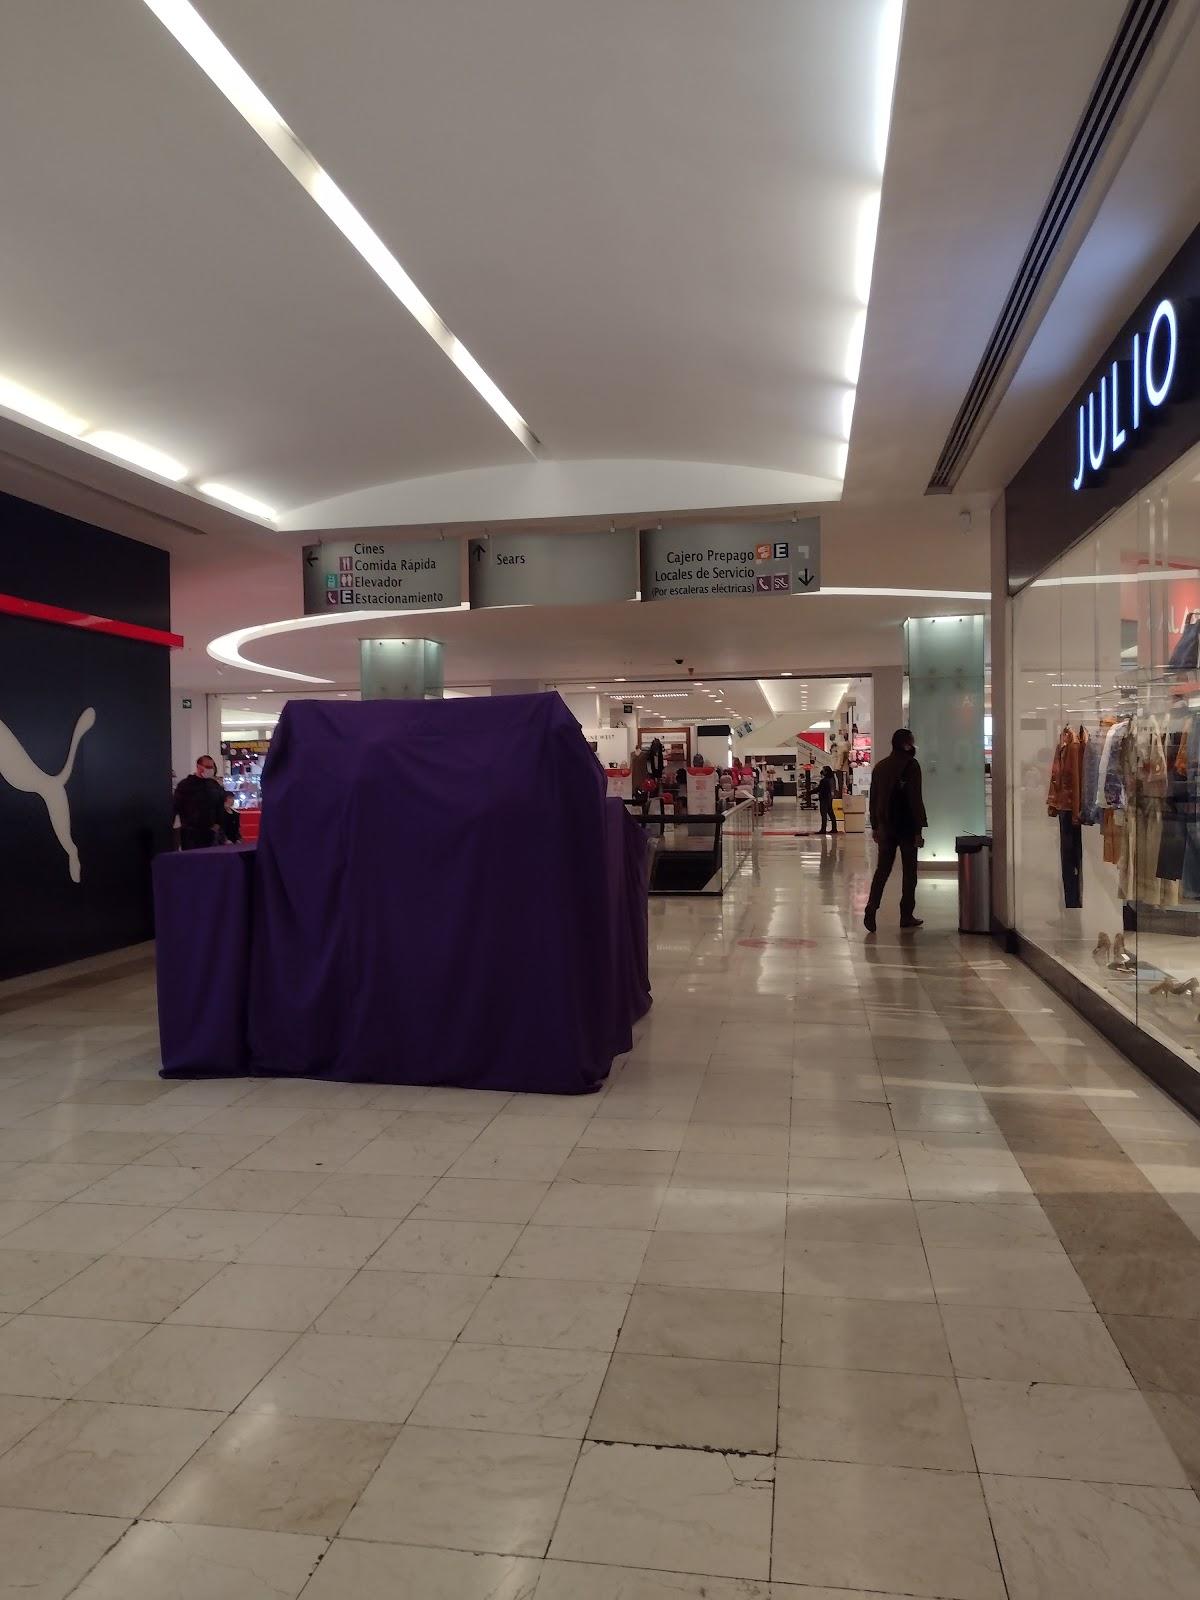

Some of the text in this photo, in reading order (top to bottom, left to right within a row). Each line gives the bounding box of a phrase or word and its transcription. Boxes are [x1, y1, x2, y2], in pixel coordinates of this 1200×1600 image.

[1073, 299, 1177, 491] JULIO
[354, 543, 385, 555] Cines
[354, 557, 436, 573] Comida Rápida
[496, 553, 526, 566] Sears
[666, 549, 755, 566] Cajero Prepago
[655, 566, 755, 582] Locales de Servicio
[355, 576, 402, 588] Elevador
[355, 591, 444, 604] Estacionamiento
[651, 583, 755, 598] (Por escaleras eléctricas)
